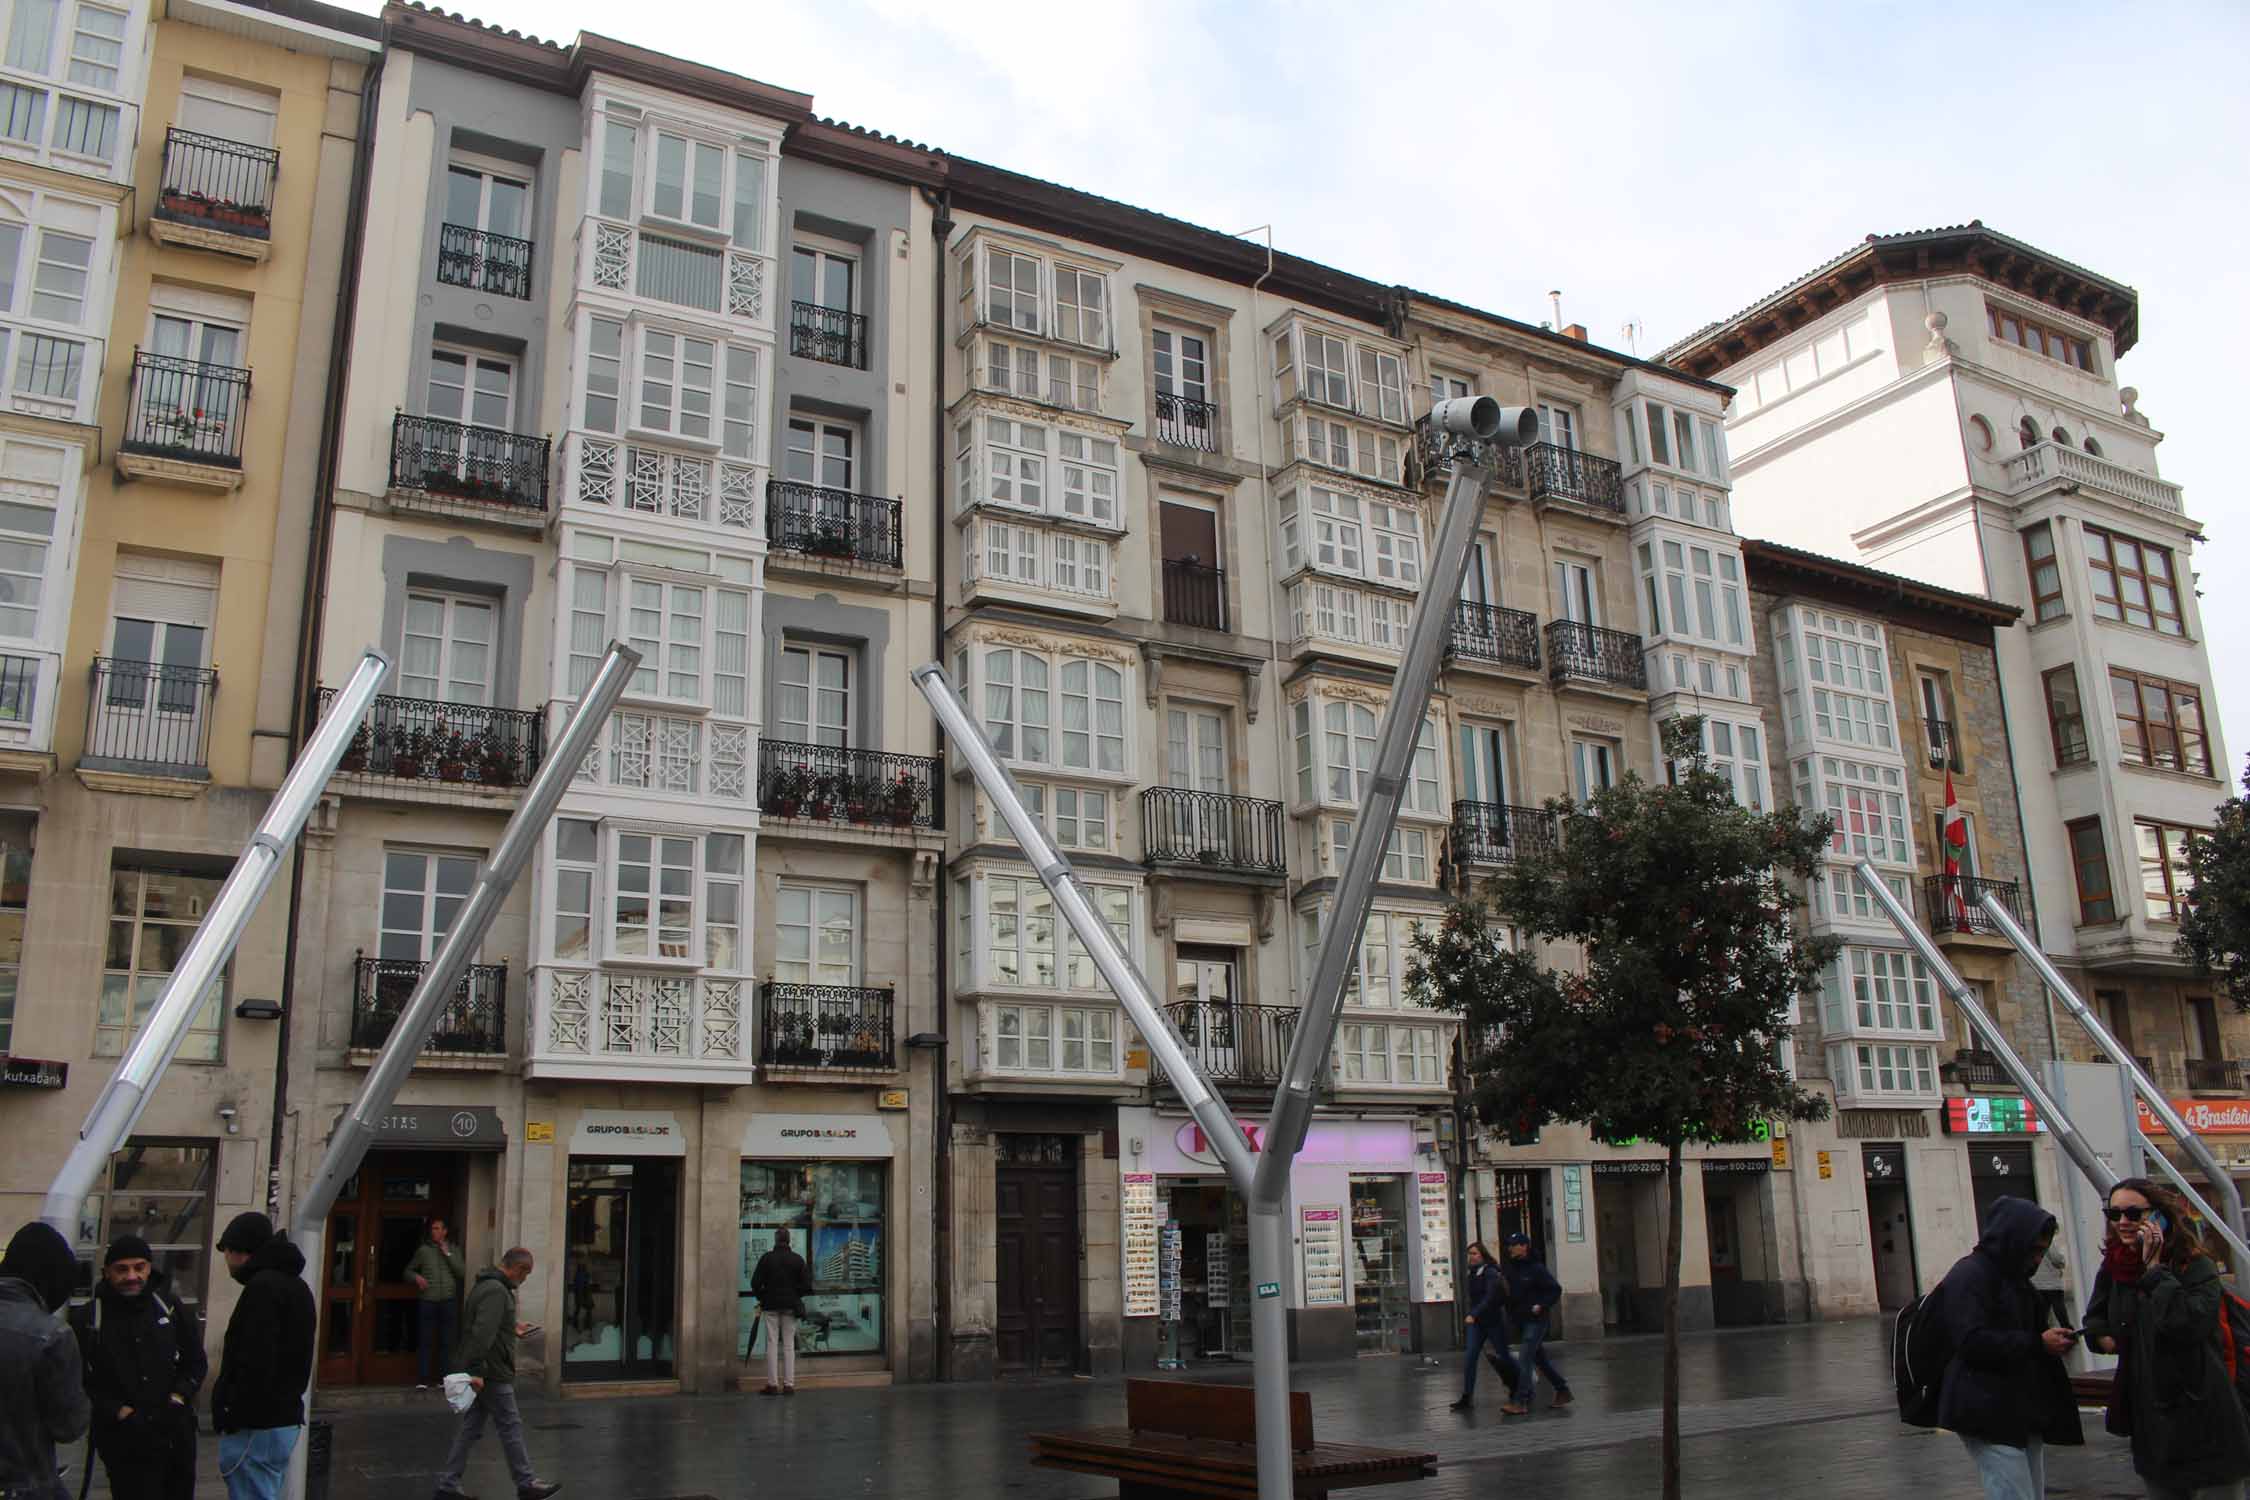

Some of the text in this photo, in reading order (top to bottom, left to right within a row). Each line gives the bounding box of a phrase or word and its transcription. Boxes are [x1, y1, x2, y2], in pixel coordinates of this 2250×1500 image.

[4, 1068, 63, 1088] kutxabank
[456, 1117, 473, 1130] 10
[2195, 1105, 2250, 1129] Brasileñ
